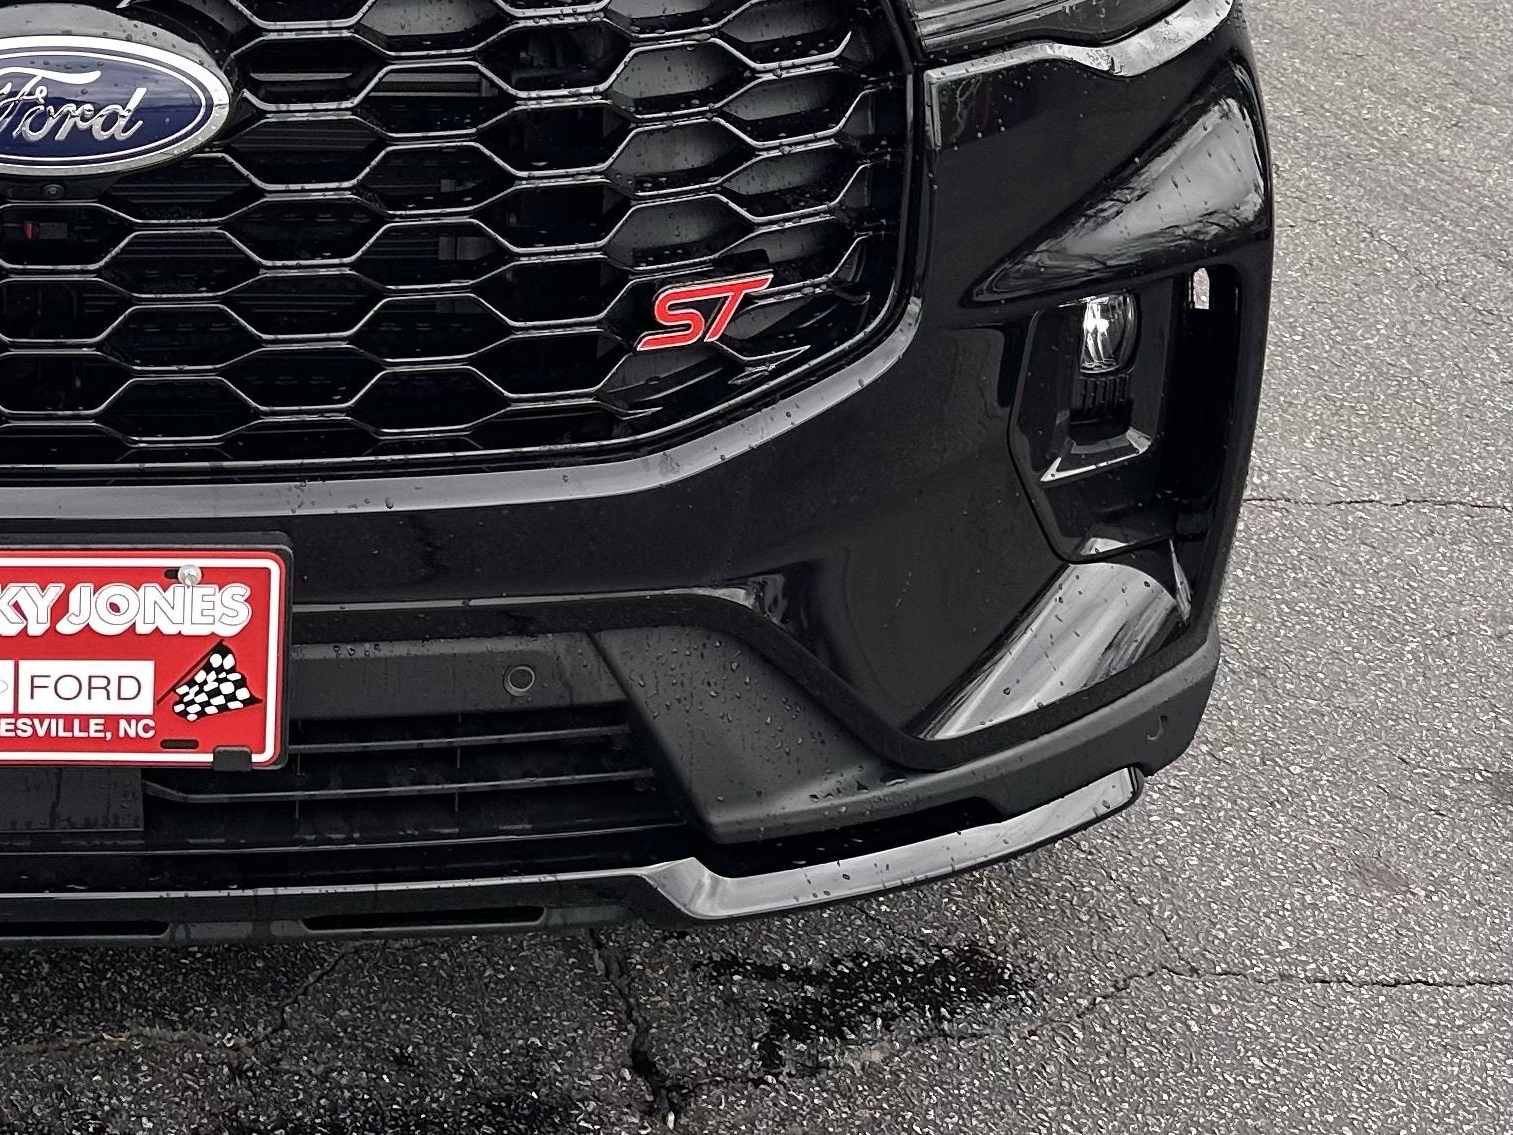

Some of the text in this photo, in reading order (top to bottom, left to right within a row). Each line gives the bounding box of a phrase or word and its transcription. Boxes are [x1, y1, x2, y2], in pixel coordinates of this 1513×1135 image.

[636, 272, 774, 352] ST
[56, 581, 253, 638] JONES
[29, 674, 142, 702] FORD
[119, 718, 156, 739] NC
